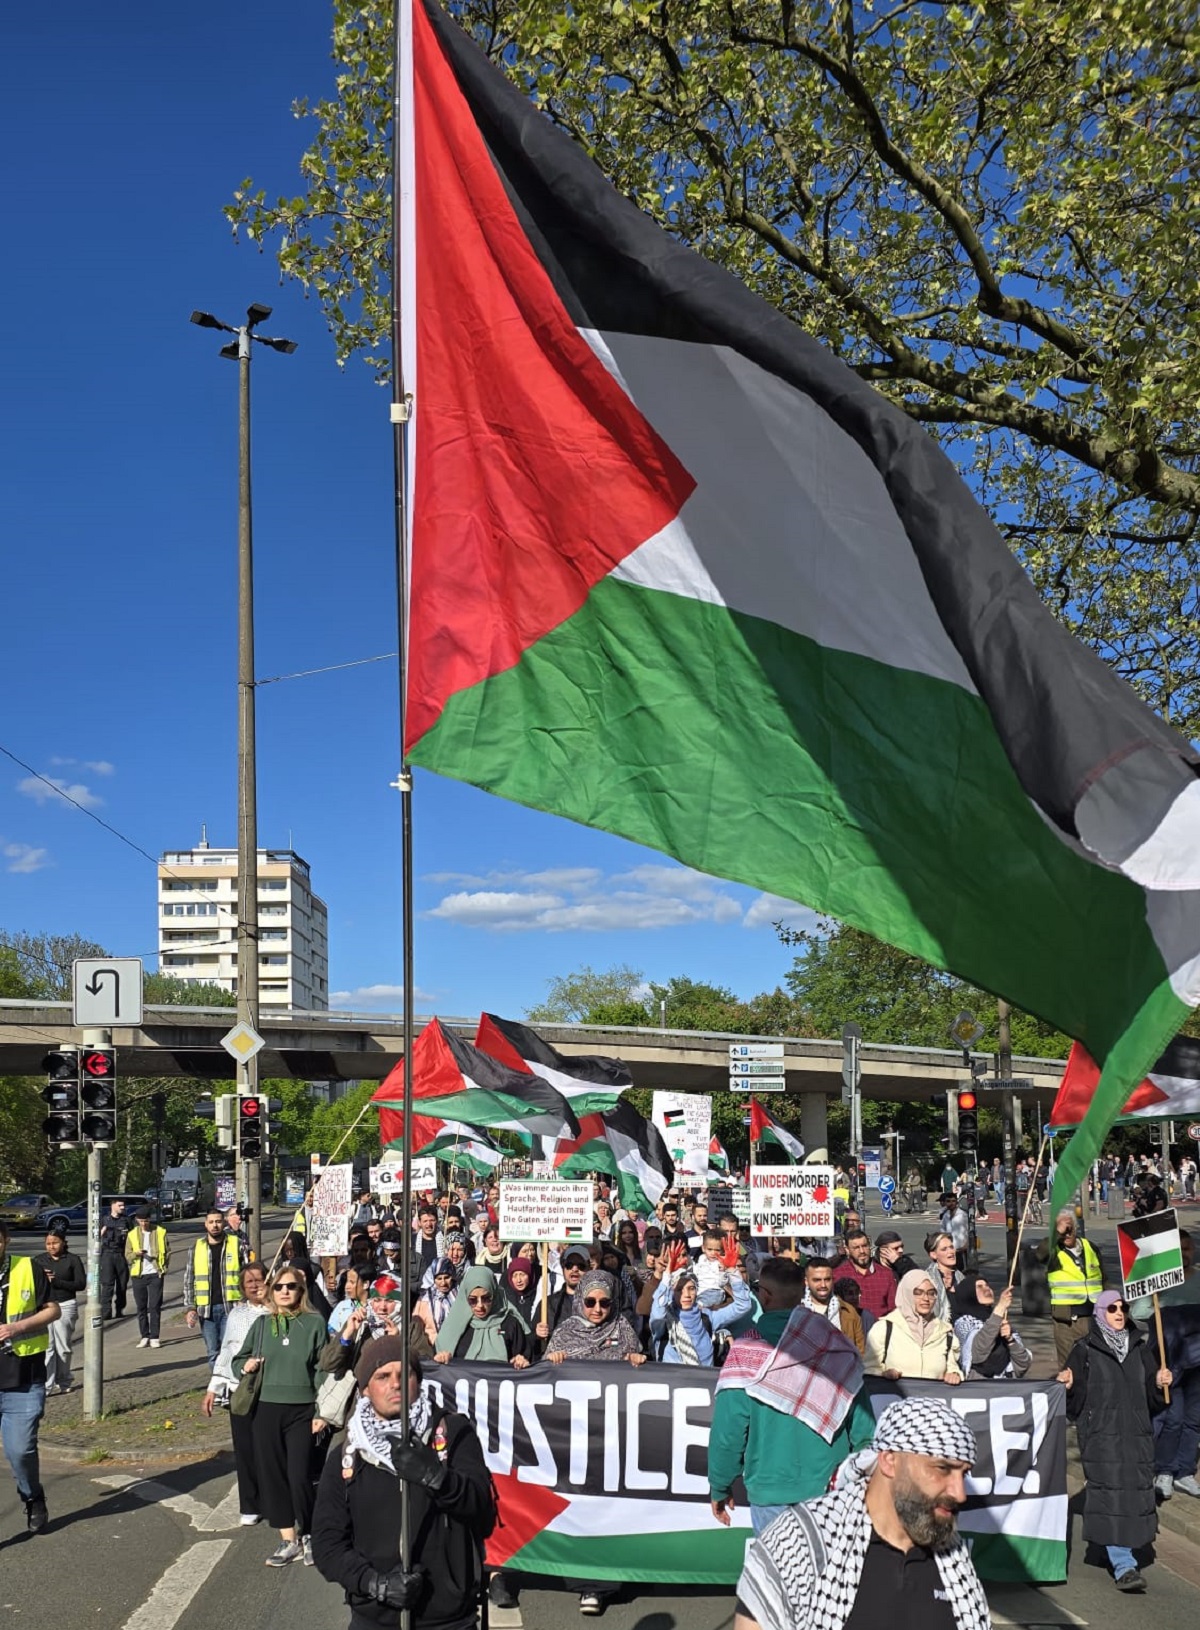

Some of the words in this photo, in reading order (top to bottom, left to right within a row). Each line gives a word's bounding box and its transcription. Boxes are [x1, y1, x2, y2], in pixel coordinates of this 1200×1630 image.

[752, 1171, 830, 1189] KINDERMÖRDER
[540, 1194, 572, 1204] Religion
[574, 1195, 589, 1203] und
[780, 1193, 803, 1207] SIND
[507, 1205, 546, 1213] Hautfarbe
[548, 1206, 565, 1214] sein
[752, 1208, 830, 1226] KINDERMÖRDER
[1125, 1280, 1147, 1300] FREE
[1147, 1268, 1184, 1292] PALESTINE
